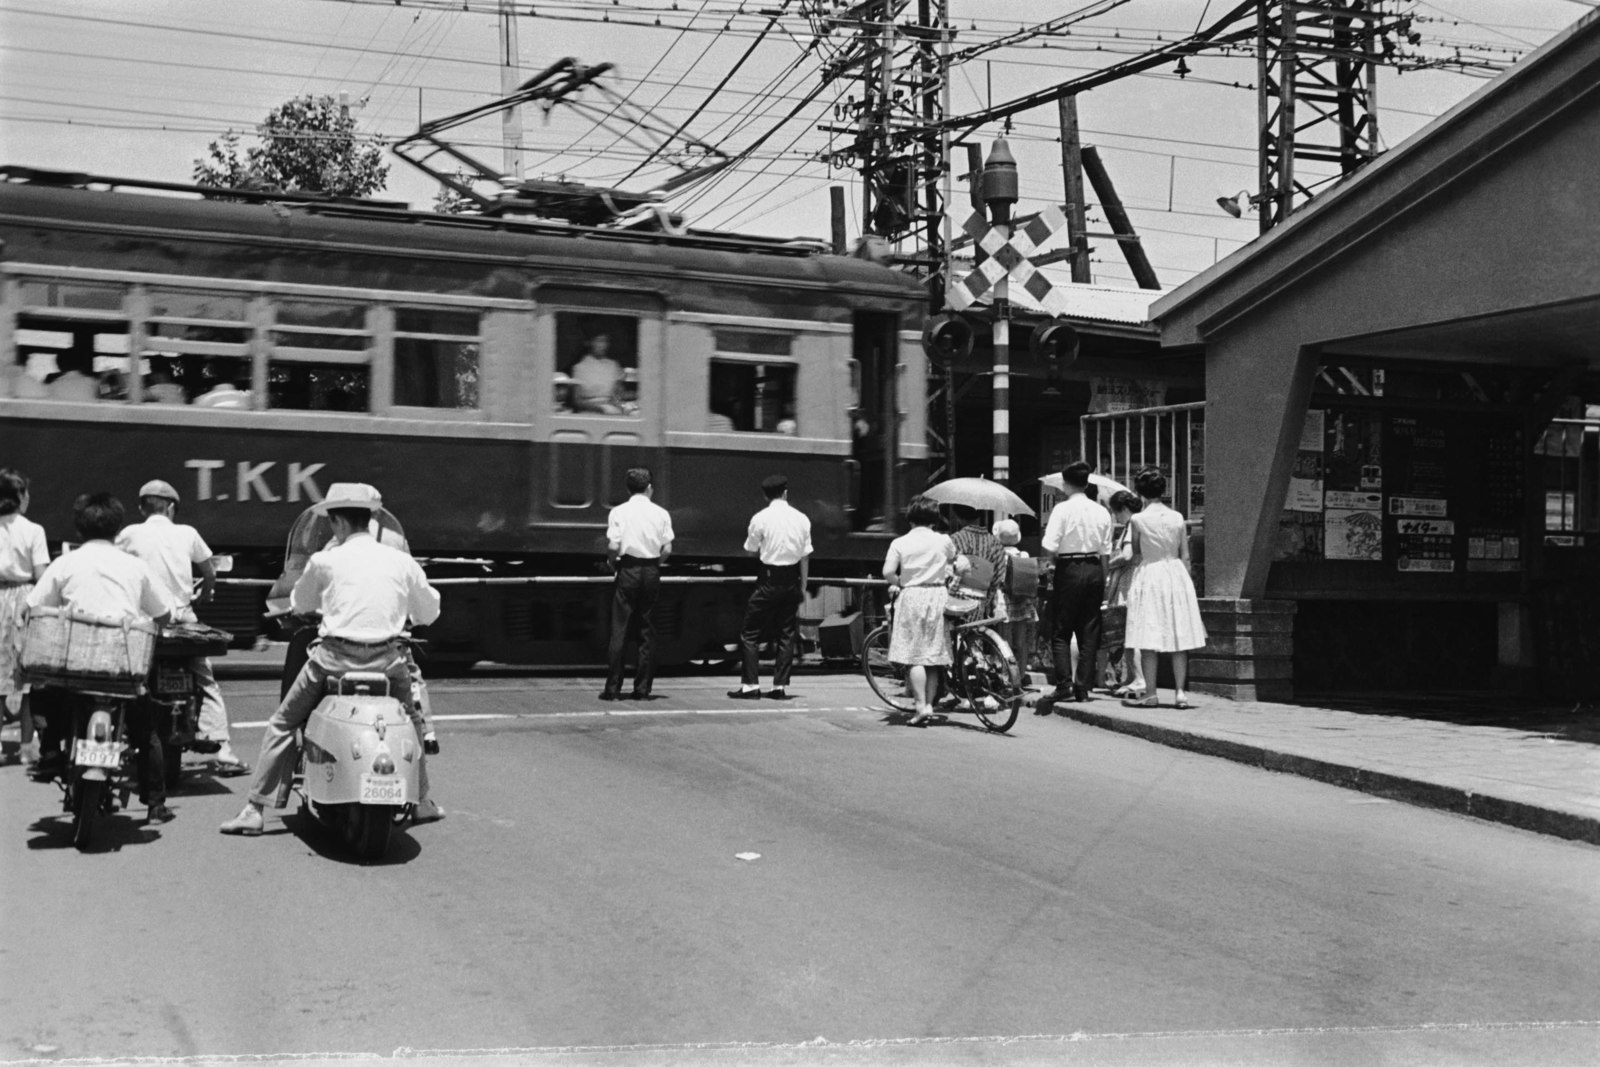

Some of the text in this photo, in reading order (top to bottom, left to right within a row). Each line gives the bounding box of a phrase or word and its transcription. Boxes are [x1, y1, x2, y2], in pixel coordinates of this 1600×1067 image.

[1402, 522, 1438, 534] ナイター
[80, 751, 115, 764] 5097
[363, 786, 403, 799] 26064
